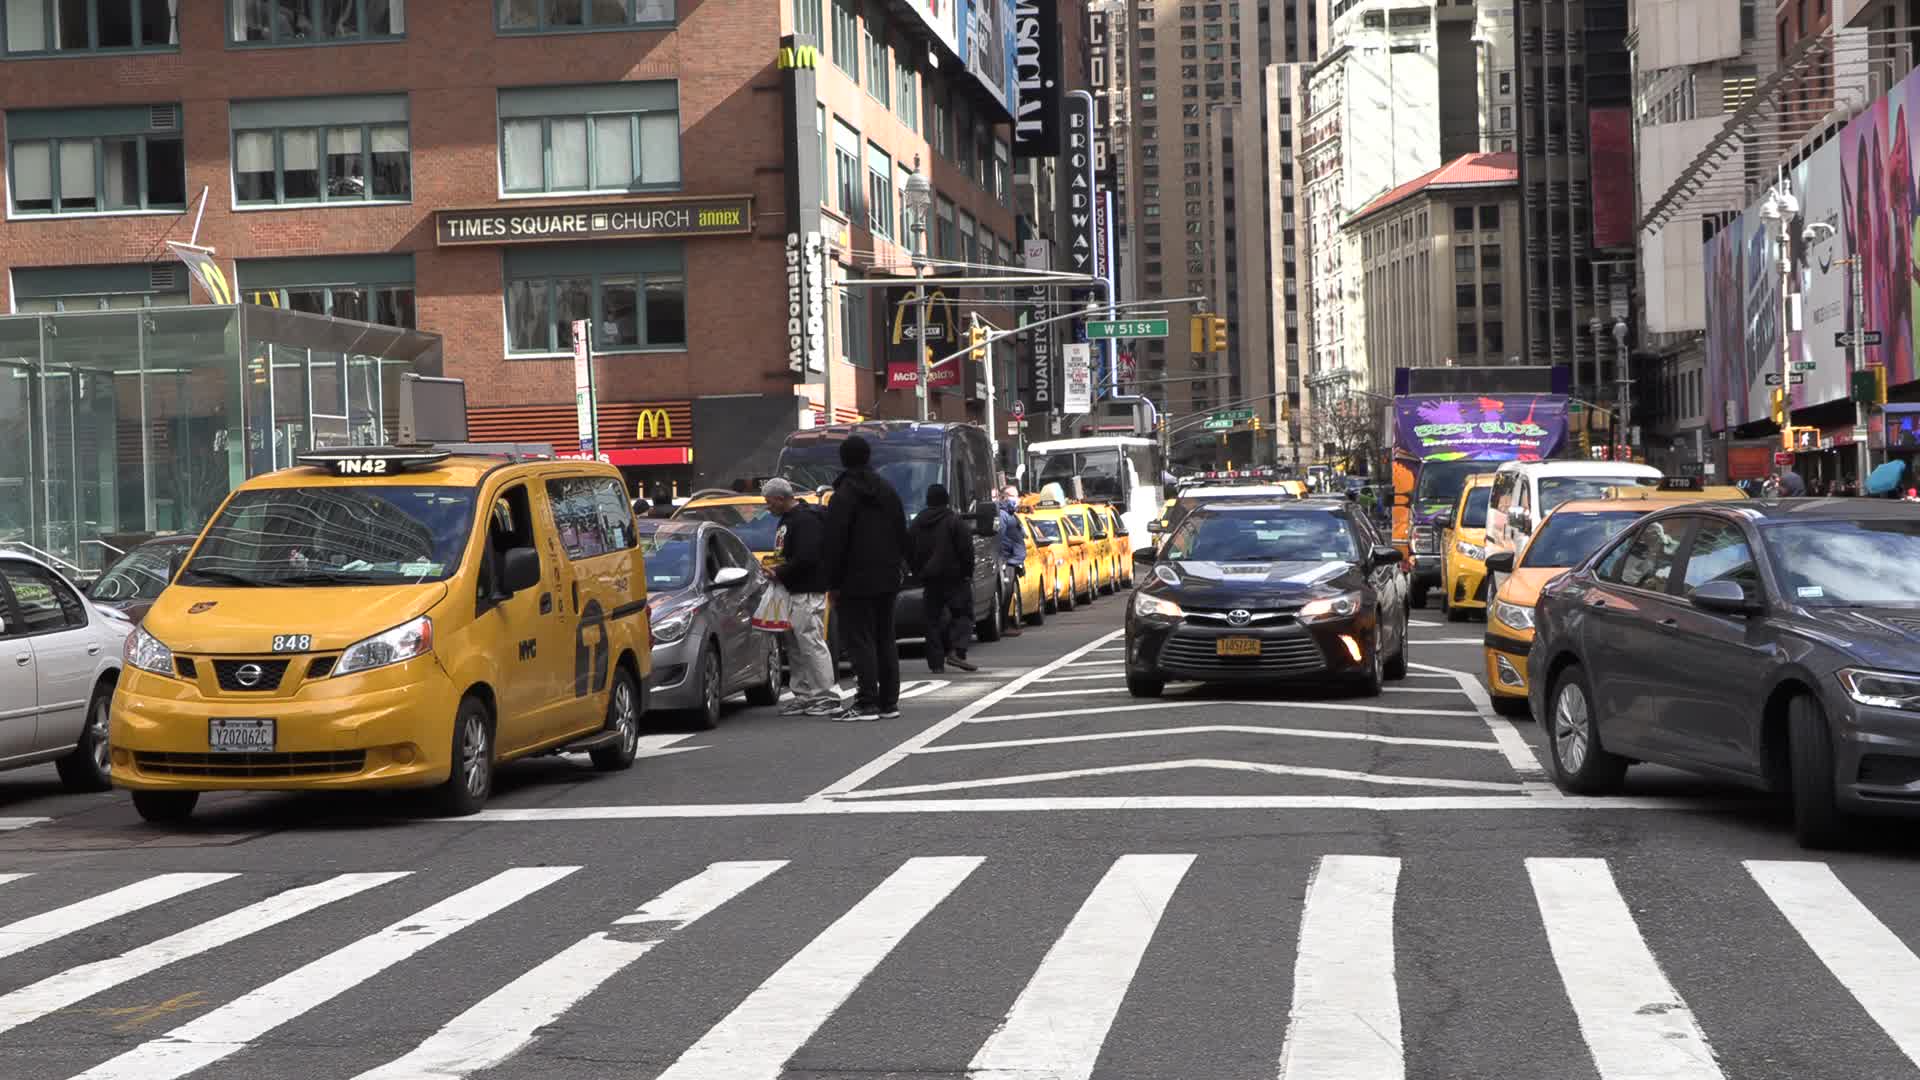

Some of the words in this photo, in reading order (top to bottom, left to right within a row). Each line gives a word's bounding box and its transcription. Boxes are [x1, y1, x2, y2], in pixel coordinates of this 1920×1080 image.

[1070, 113, 1089, 268] BROADWAY
[447, 217, 506, 237] TIMES
[510, 213, 588, 235] SQUARE
[611, 209, 690, 230] CHURCH
[698, 208, 741, 227] annex
[786, 232, 803, 373] McDonald's
[1104, 324, 1115, 335] W
[1119, 324, 1133, 335] 51
[1137, 323, 1151, 334] St
[337, 459, 387, 473] 1N42
[273, 635, 310, 651] 848
[216, 729, 268, 745] Y202062C
